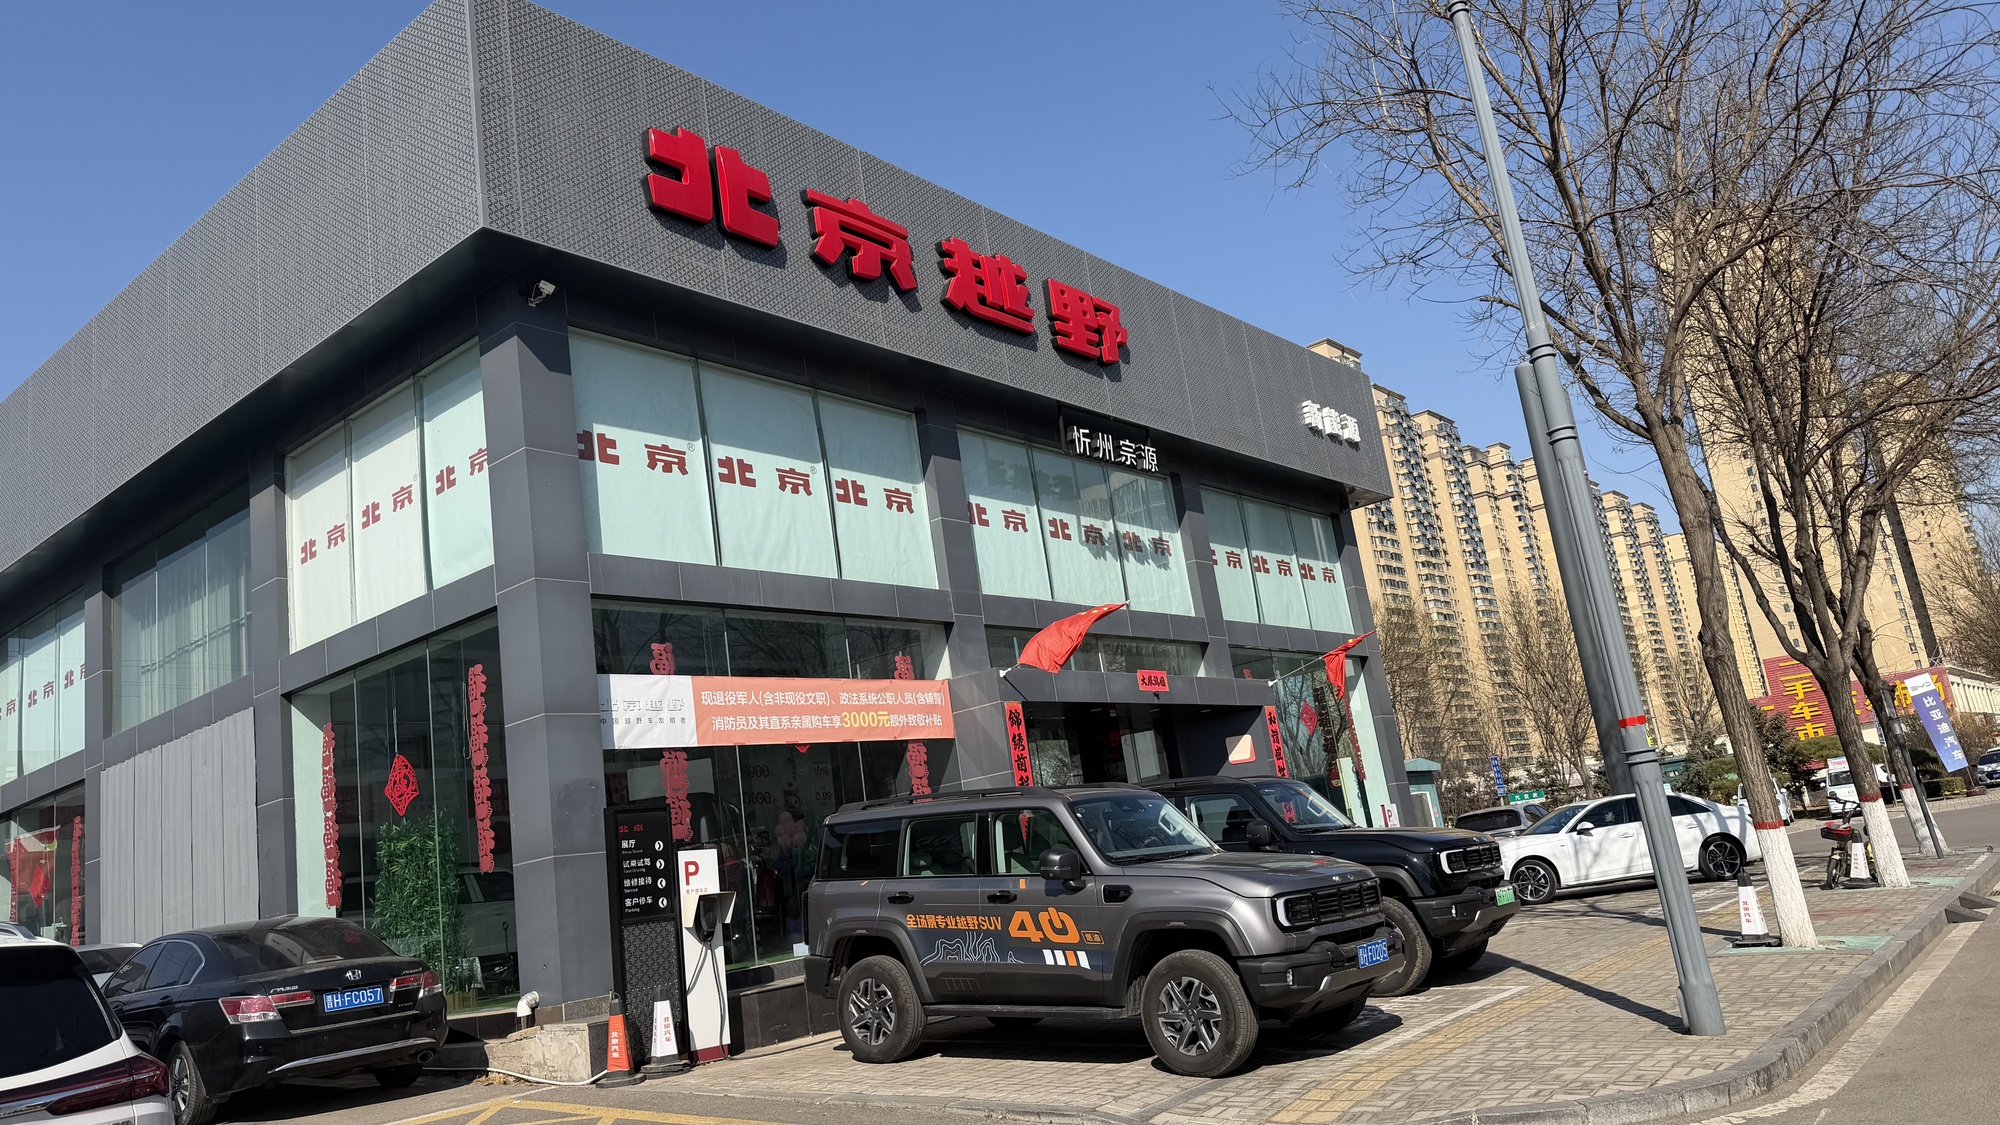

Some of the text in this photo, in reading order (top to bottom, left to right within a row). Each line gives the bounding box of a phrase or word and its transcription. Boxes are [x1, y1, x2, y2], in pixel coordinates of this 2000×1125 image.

[644, 127, 1128, 365] 北京越野
[1071, 425, 1159, 472] 忻州宗源
[718, 455, 813, 497] 北京
[361, 483, 414, 530] 北京
[835, 477, 915, 515] 北京
[300, 523, 346, 565] 北京
[1048, 517, 1105, 547] 北京
[1122, 530, 1173, 557] 北京
[1252, 554, 1293, 577] 北京
[1299, 562, 1337, 583] 北京
[28, 681, 55, 709] 北京
[1910, 681, 1932, 692] BYD
[1922, 696, 1965, 761] 比亚迪汽车
[618, 824, 643, 833] 北京
[1387, 809, 1392, 822] P
[621, 839, 636, 849] 展厅
[623, 858, 651, 868] 试乘试驾
[684, 861, 700, 886] P
[624, 876, 652, 887] 维修接待
[625, 896, 653, 907] 客户停车
[905, 914, 1002, 931] 全场景专业越野SUV
[1008, 907, 1080, 944] 40
